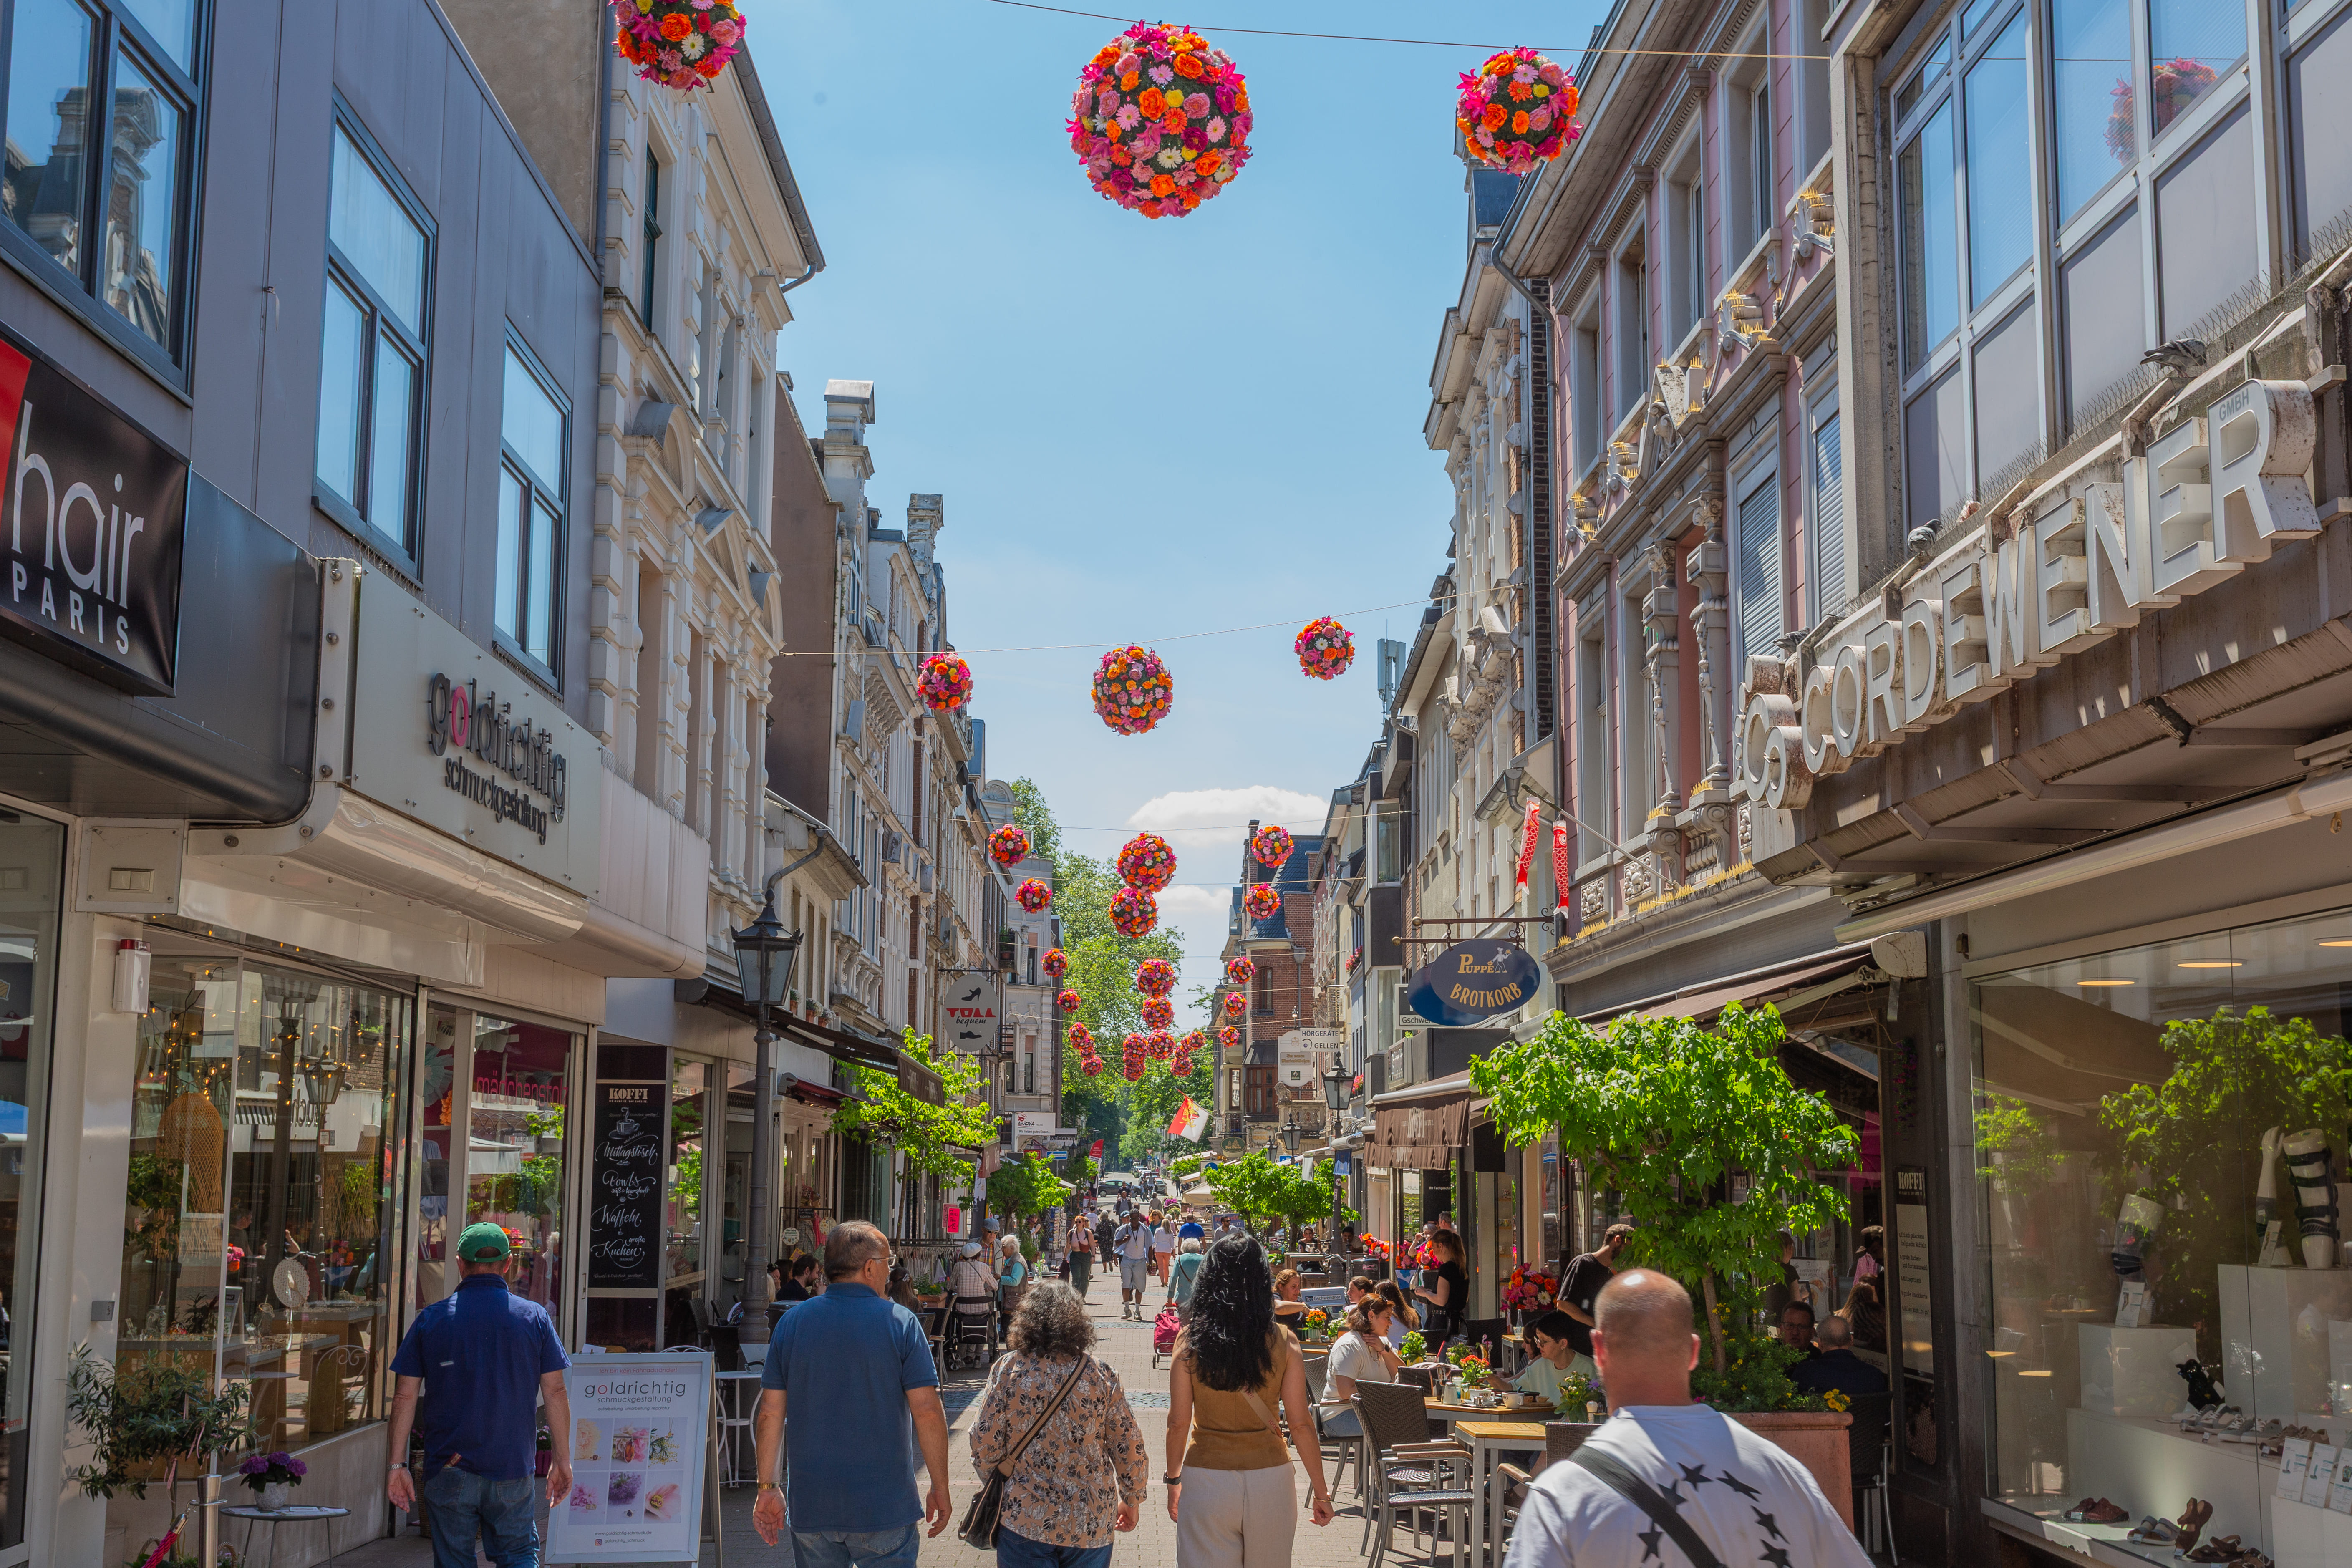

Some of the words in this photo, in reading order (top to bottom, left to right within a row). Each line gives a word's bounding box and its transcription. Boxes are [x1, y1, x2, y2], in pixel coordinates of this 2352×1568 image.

[2218, 387, 2250, 421] GMBH
[12, 399, 144, 610] hair
[1802, 379, 2316, 774] CORDEWENER
[13, 561, 129, 655] PARIS
[431, 672, 566, 824] goldrichtig
[445, 756, 547, 845] schmuckgestaltung
[1450, 983, 1522, 1008] BROTKORB
[946, 1008, 996, 1018] TOLL
[955, 1015, 986, 1027] bequem
[476, 1070, 568, 1108] mädchenstolz
[609, 1088, 648, 1099] KOFFI
[595, 1141, 658, 1165] Mittagstisch
[602, 1170, 656, 1187] Bowls
[1898, 1172, 1923, 1190] KOFFI
[590, 1204, 642, 1230] Waffeln
[590, 1238, 645, 1259] Kuchen
[625, 1235, 645, 1246] große
[585, 1381, 686, 1398] goldrichtig
[8, 1416, 23, 1428] termin
